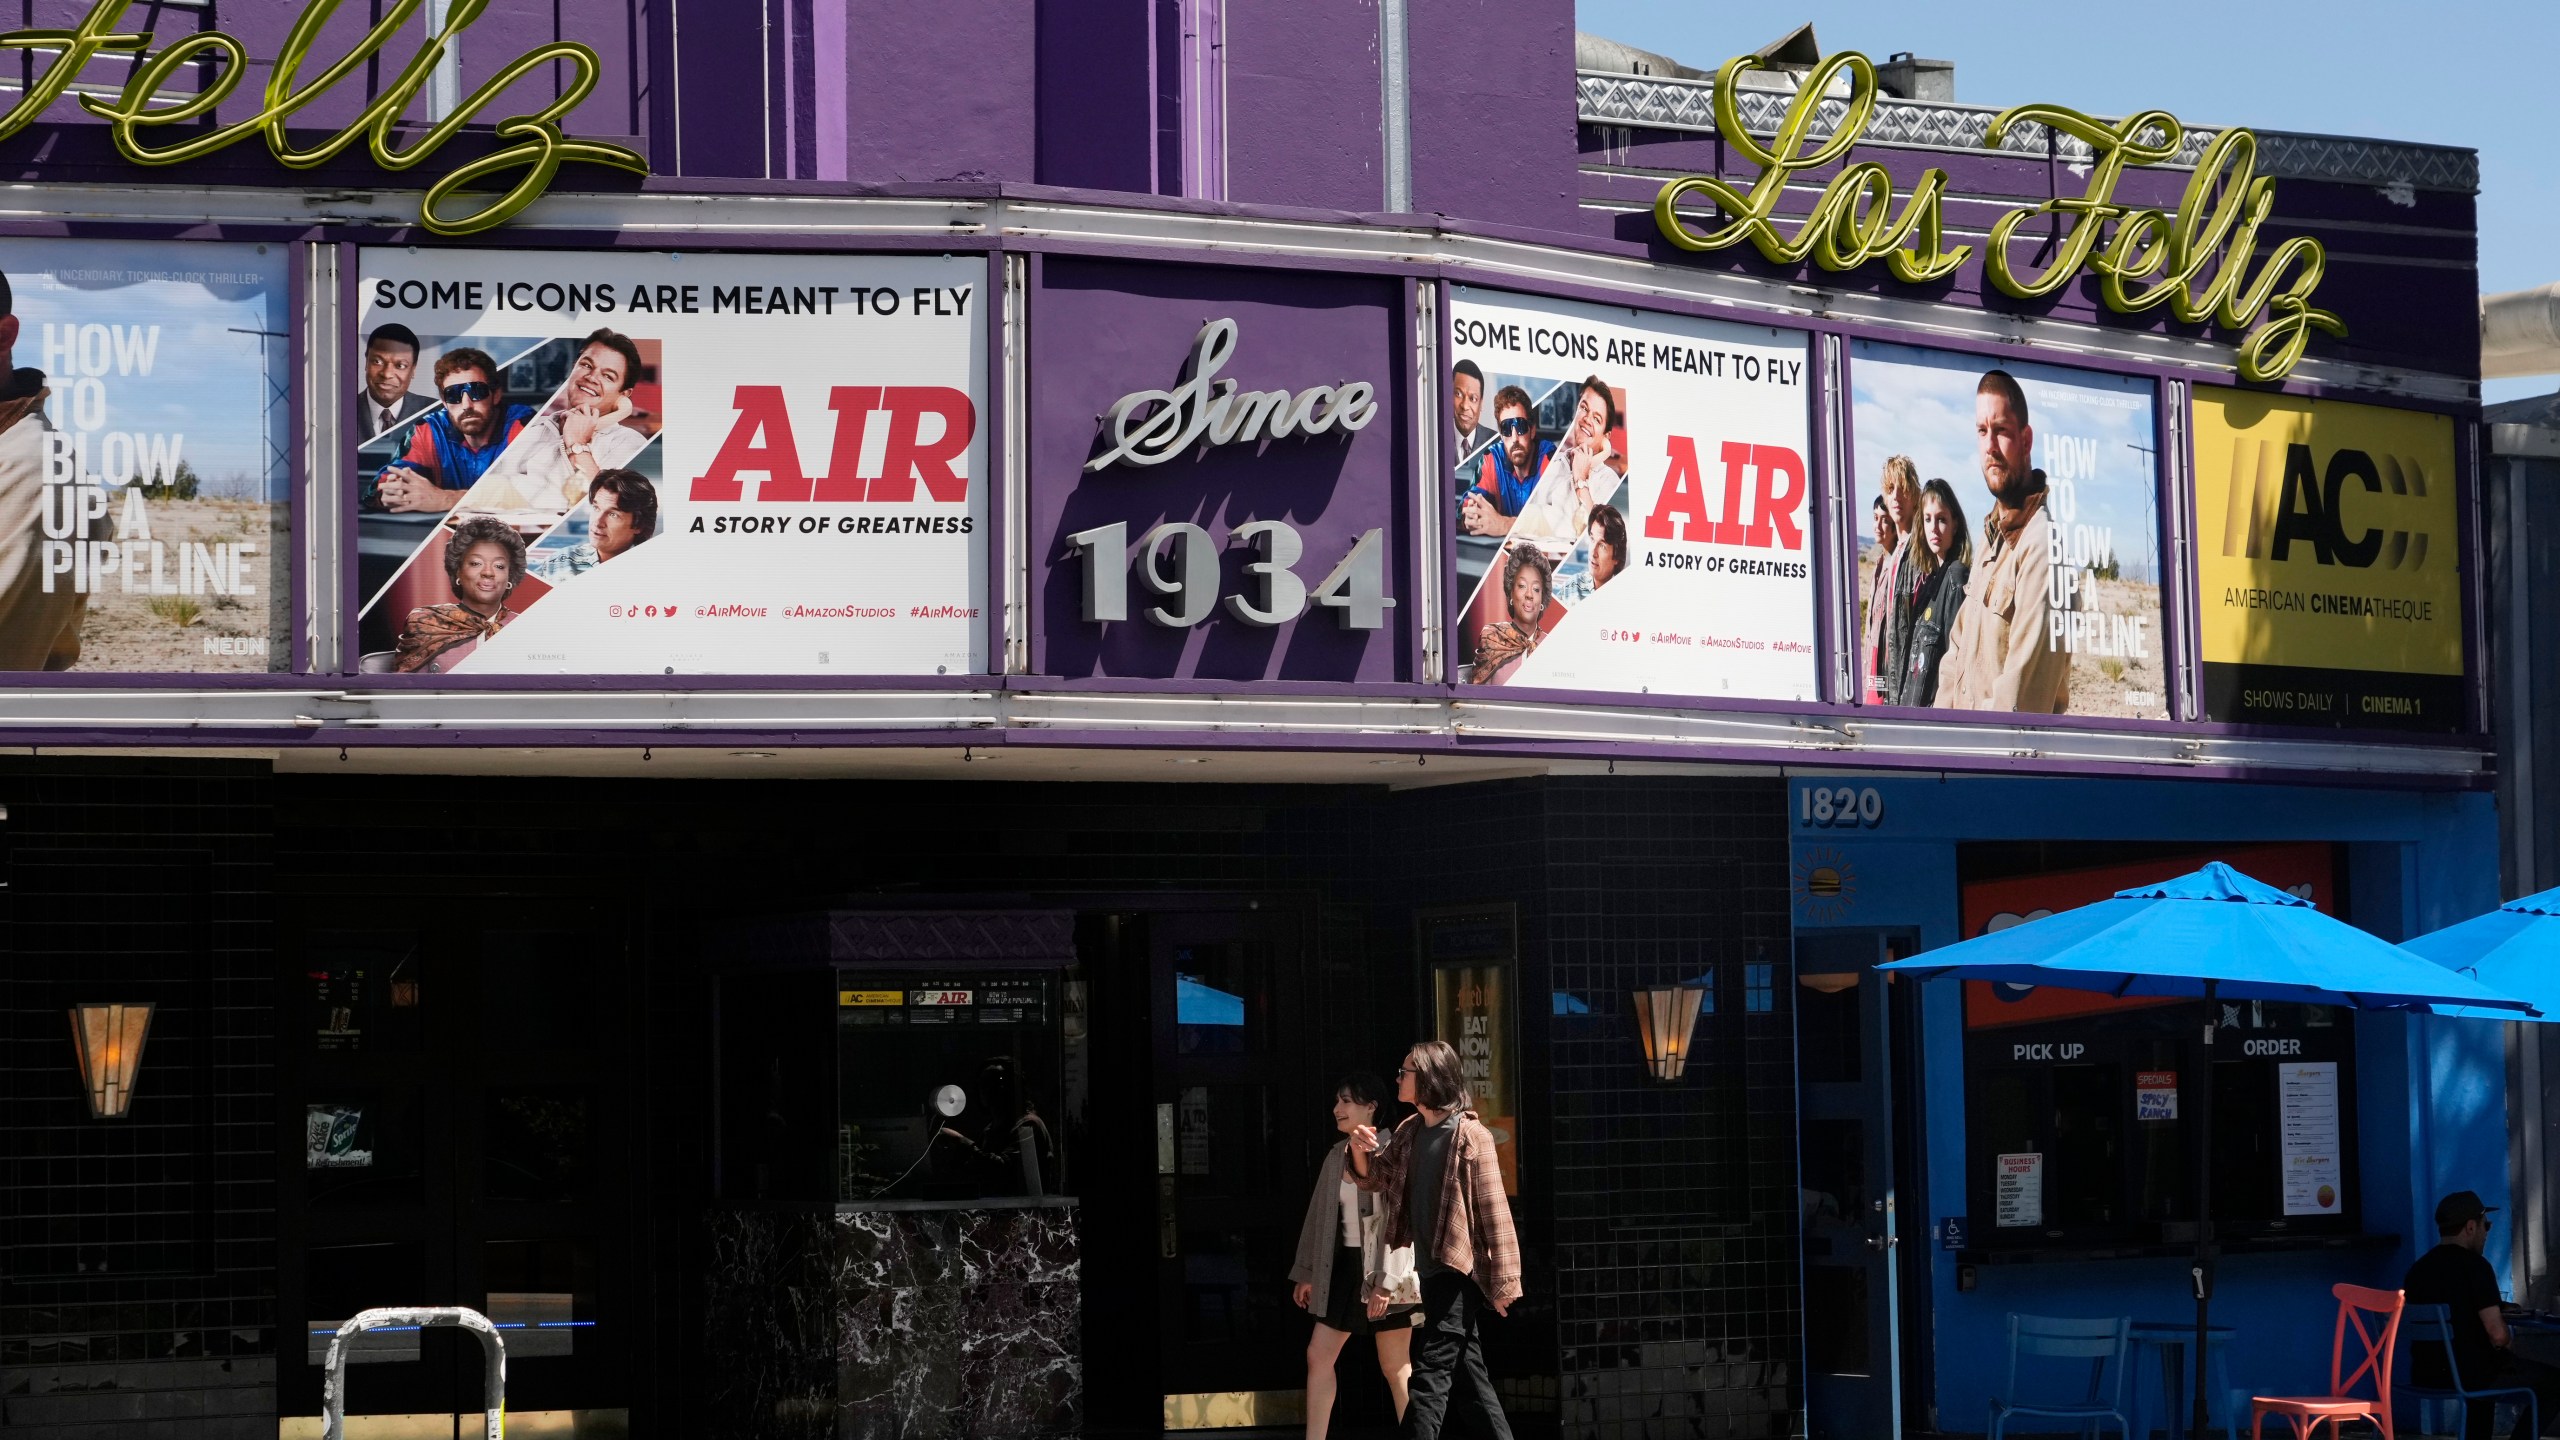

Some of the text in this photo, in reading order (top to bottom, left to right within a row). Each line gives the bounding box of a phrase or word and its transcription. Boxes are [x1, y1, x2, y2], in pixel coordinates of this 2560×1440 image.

[1653, 50, 2349, 383] Los Feliz
[128, 271, 206, 284] TICKING-CLOCK
[375, 280, 971, 318] SOME ICONS ARE MEANT TO FLY
[43, 323, 160, 376] HOW
[1454, 318, 1801, 386] SOME ICONS ARE MEANT TO FLY
[43, 376, 106, 430] TO
[1083, 317, 1378, 473] Since
[43, 431, 183, 486] BLOW
[689, 385, 976, 503] AIR
[2043, 433, 2097, 480] HOW
[43, 484, 150, 539] UP A
[1644, 435, 1806, 550] AIR
[2046, 482, 2076, 522] TO
[2271, 442, 2384, 569] AC
[690, 516, 974, 535] A STORY OF GREATNESS
[2047, 522, 2112, 568] BLOW
[43, 540, 256, 595] PIPELINE
[1065, 520, 1397, 631] 1934
[1645, 551, 1807, 578] A STORY OF GREATNESS
[2048, 564, 2098, 610] UP A
[2224, 587, 2433, 622] AMERICAN CINEMATHEQUE
[203, 637, 265, 655] NEON
[2050, 609, 2148, 658] PIPELINE
[2125, 690, 2155, 707] NEON
[2243, 690, 2421, 715] SHOWS DAILY CINEMA 1
[1801, 786, 1884, 829] 1820
[937, 992, 968, 1004] AIR
[1464, 1016, 1488, 1034] EAT
[1460, 1038, 1492, 1060] NOW,
[2013, 1043, 2084, 1061] PICK UP
[2243, 1038, 2302, 1056] ORDER
[1464, 1059, 1490, 1078] DINE
[2138, 1075, 2172, 1084] SPECIALS
[2139, 1106, 2172, 1119] RANCH
[2141, 1093, 2169, 1107] SPICY
[332, 1124, 357, 1148] Sprite
